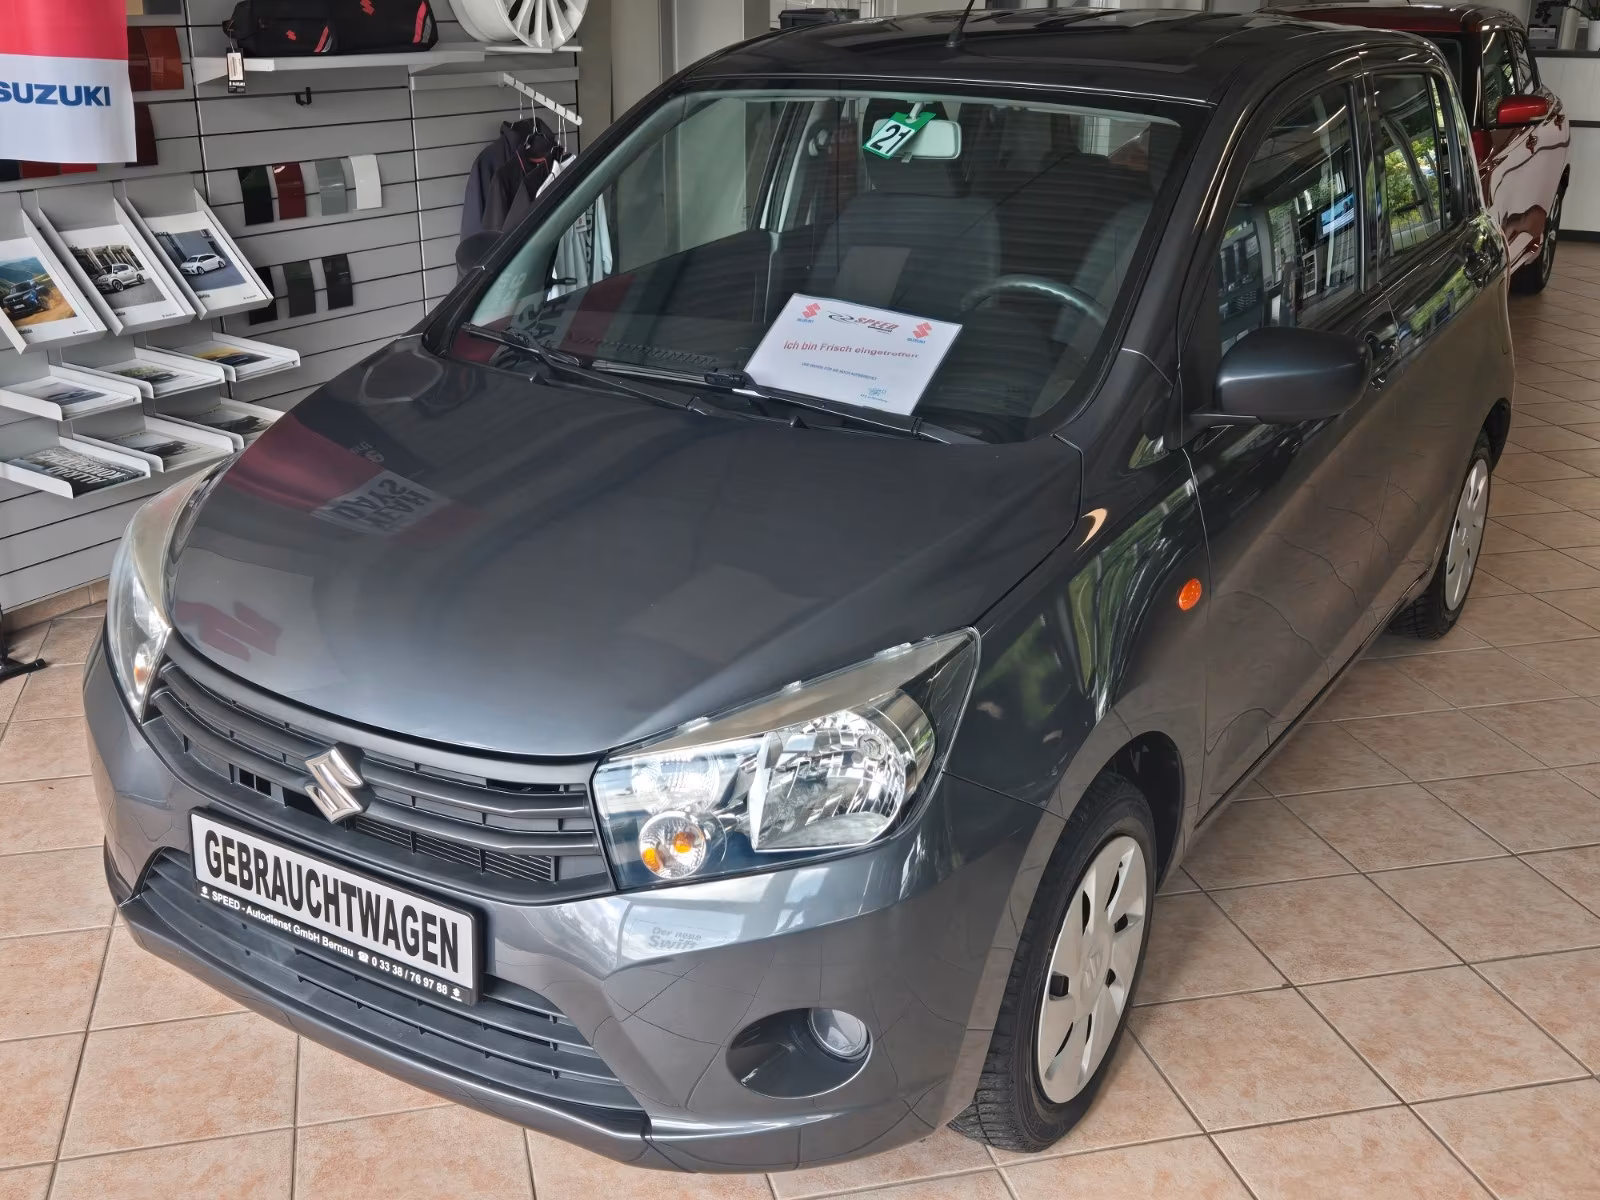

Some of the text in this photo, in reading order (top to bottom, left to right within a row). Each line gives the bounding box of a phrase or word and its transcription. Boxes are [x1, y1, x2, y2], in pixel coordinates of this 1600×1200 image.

[0, 82, 111, 106] SUZUKI
[870, 124, 912, 155] 21
[855, 316, 899, 331] SPEED
[783, 340, 918, 358] Ich bin Frisch eingetroffen
[204, 829, 459, 974] GEBRAUCHTWAGEN
[212, 890, 240, 910] SPEED
[246, 905, 292, 932] Autodienst
[293, 925, 320, 944] GmbH
[321, 936, 354, 957] Bernau
[371, 957, 378, 967] 0
[379, 959, 390, 972] 33
[392, 964, 403, 977] 38
[410, 971, 421, 984] 76
[423, 977, 434, 990] 97
[436, 982, 447, 995] 88
